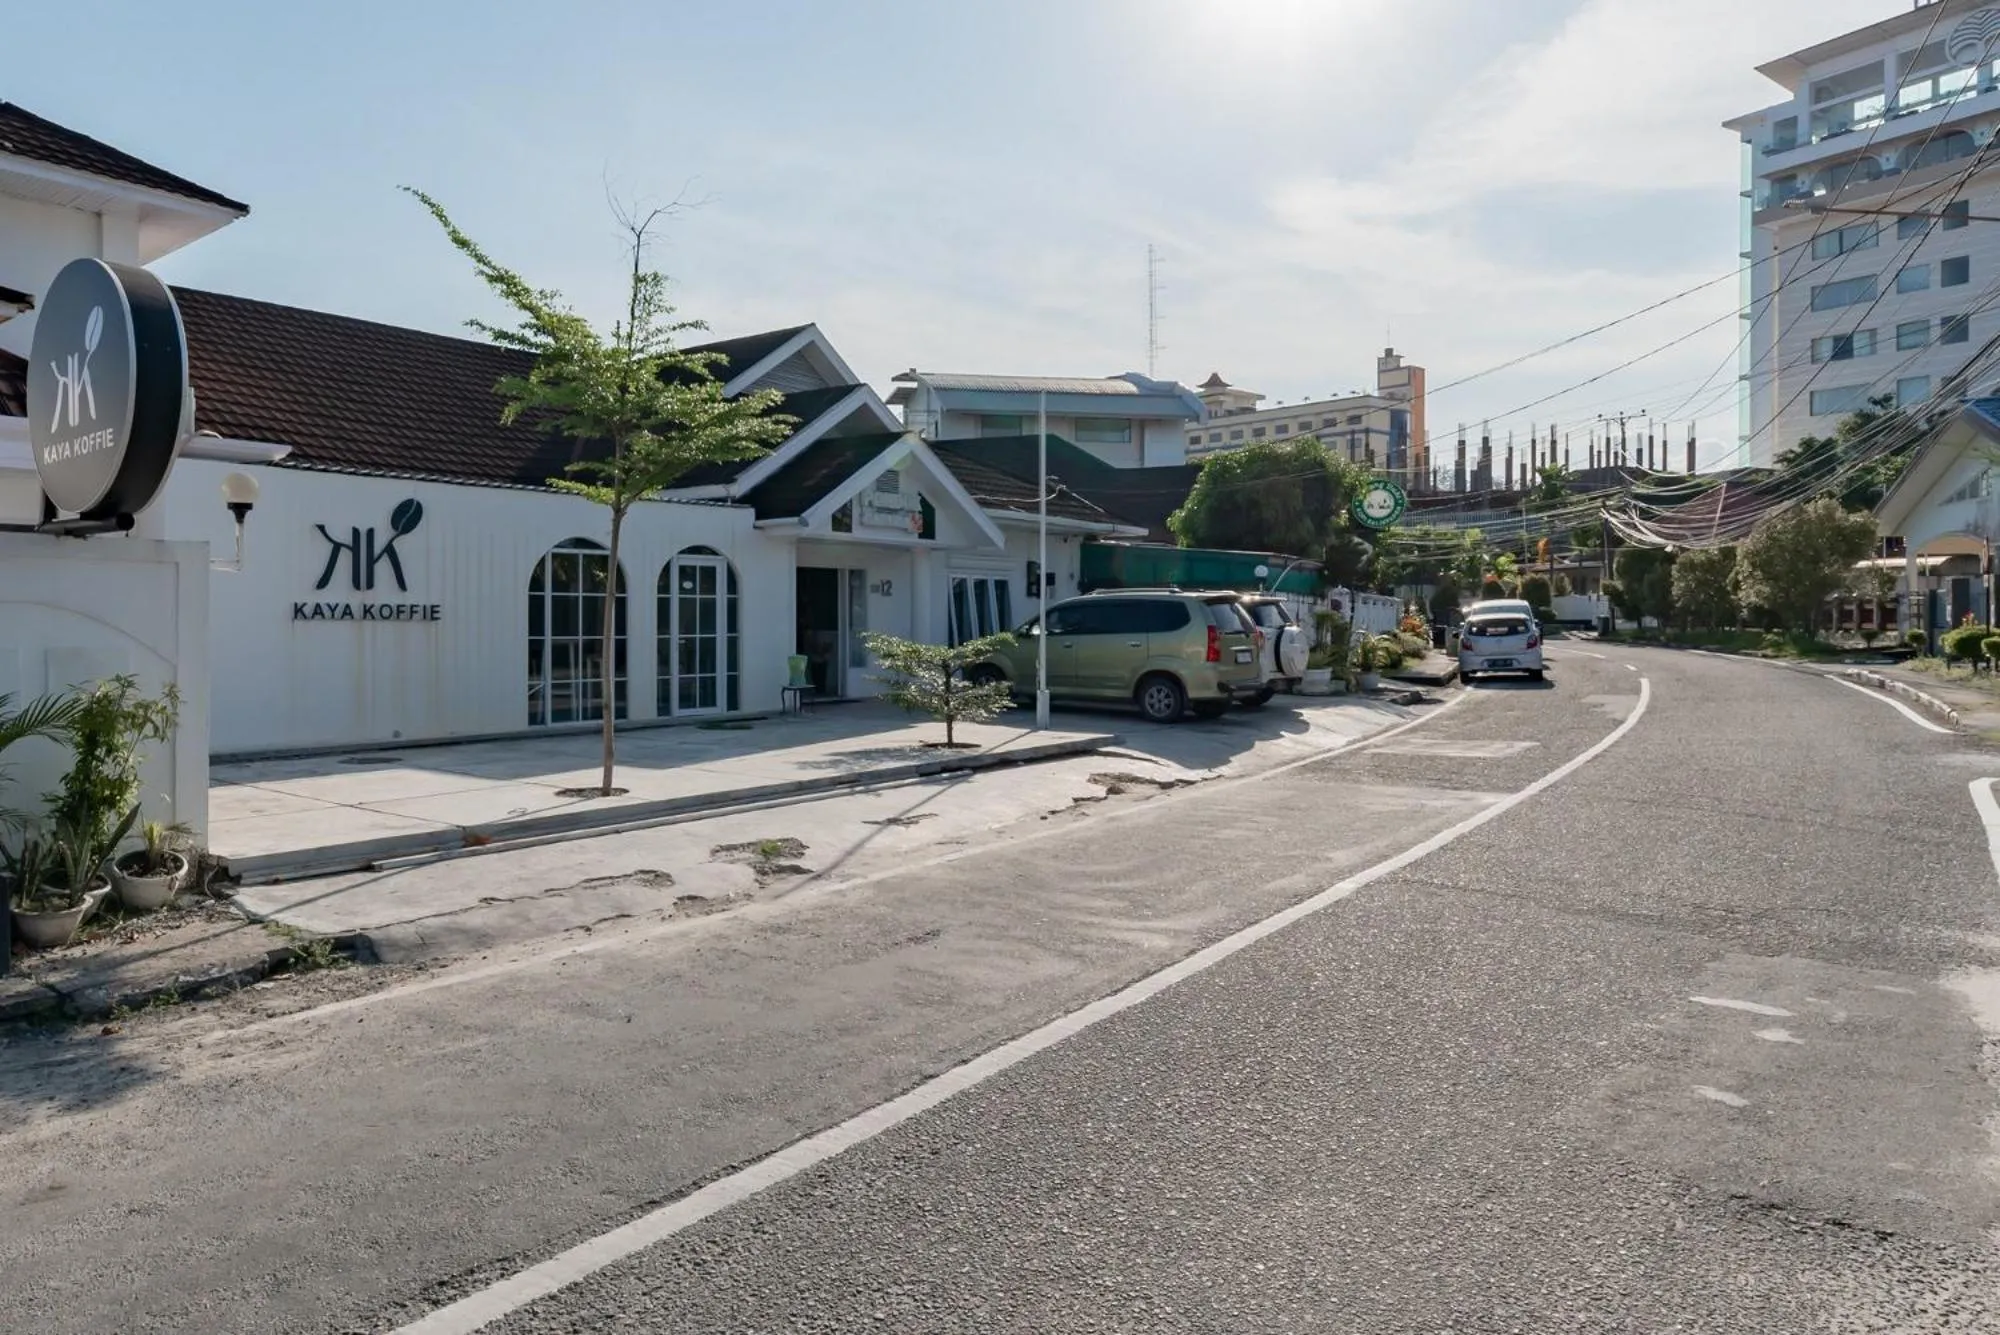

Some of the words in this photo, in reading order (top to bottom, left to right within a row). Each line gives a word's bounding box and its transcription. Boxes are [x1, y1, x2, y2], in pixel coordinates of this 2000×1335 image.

[43, 440, 71, 465] KAYA
[73, 427, 114, 457] KOFFIE
[880, 579, 893, 597] 12
[293, 602, 354, 621] KAYA
[362, 603, 441, 621] KOFFIE
